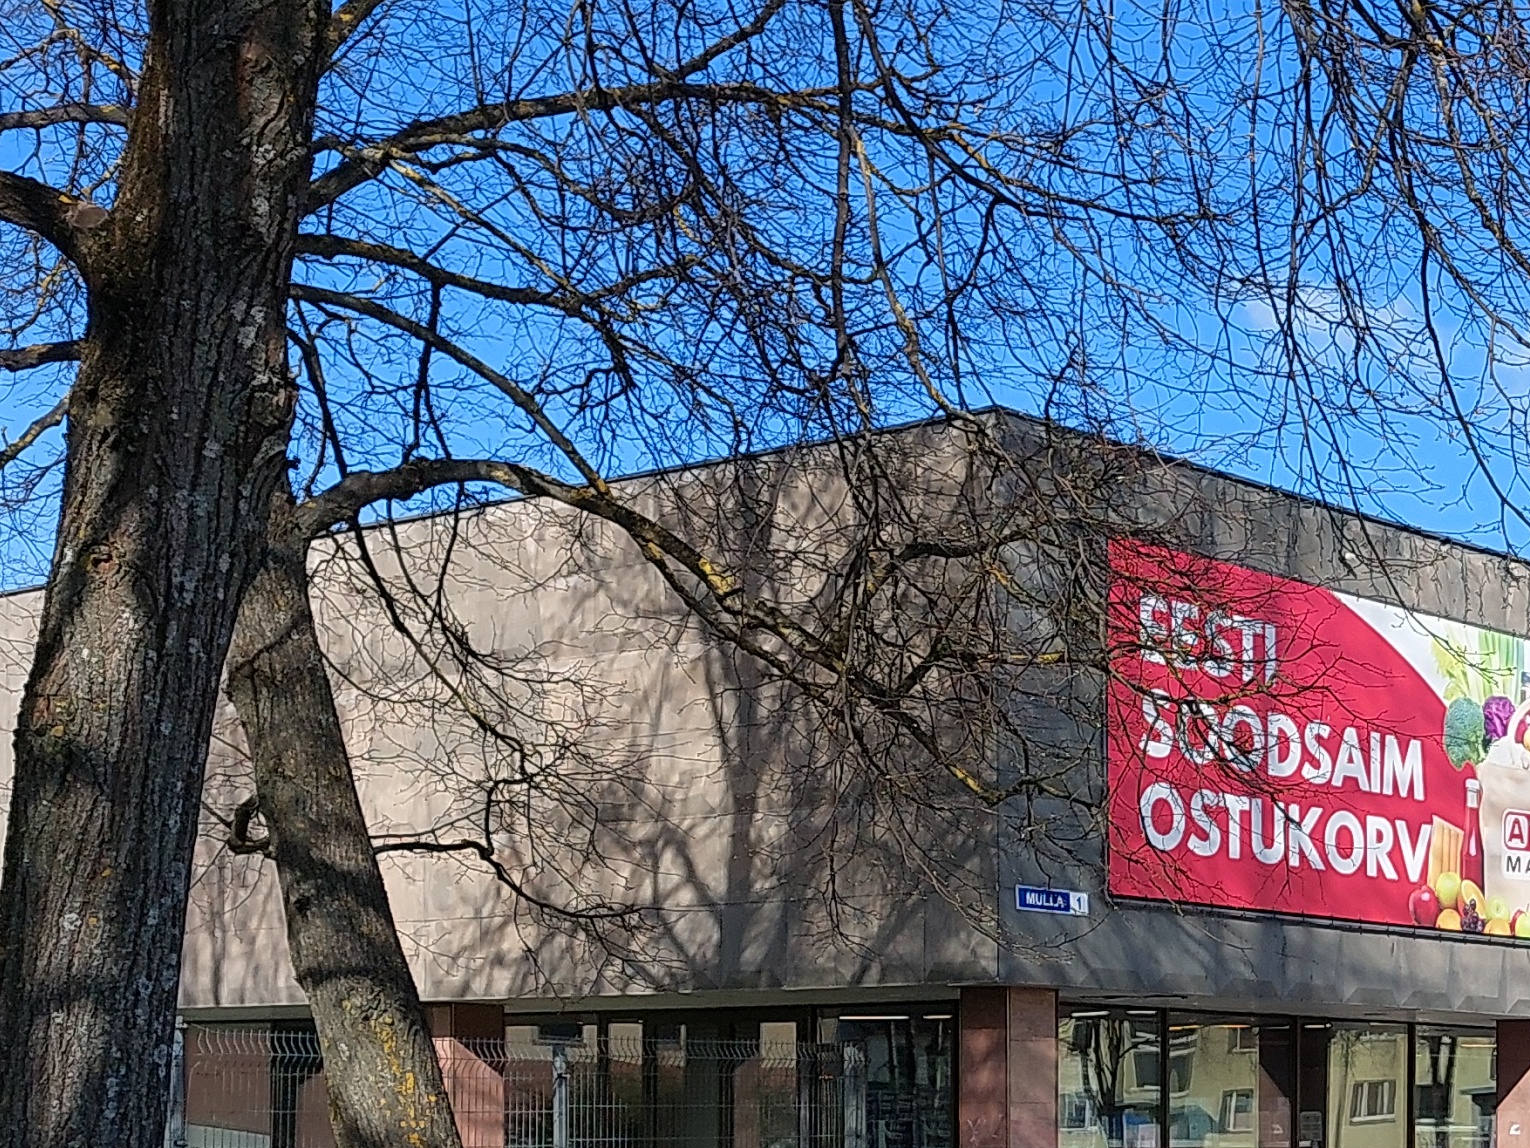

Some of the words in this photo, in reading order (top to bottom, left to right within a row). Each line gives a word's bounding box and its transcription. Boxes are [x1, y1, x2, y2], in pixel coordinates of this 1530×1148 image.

[1139, 596, 1277, 688] EESTI
[1139, 688, 1425, 801] SOODSAIM
[1139, 781, 1432, 883] OSTUKORV
[1025, 890, 1067, 910] MULLA
[1076, 895, 1084, 911] 1
